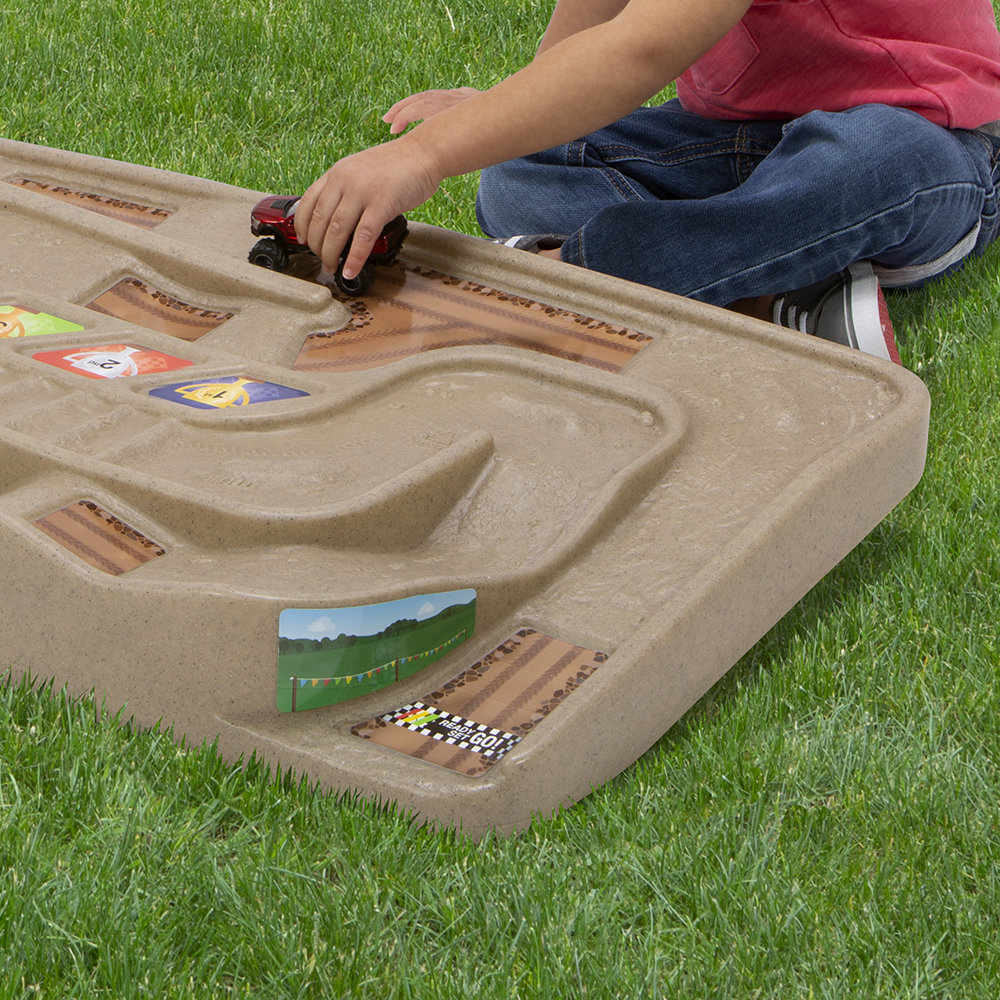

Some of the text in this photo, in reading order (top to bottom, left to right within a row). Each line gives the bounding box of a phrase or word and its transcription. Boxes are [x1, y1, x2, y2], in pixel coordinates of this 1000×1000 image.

[439, 719, 476, 735] READY
[447, 730, 471, 741] SET
[469, 732, 504, 750] GO!
